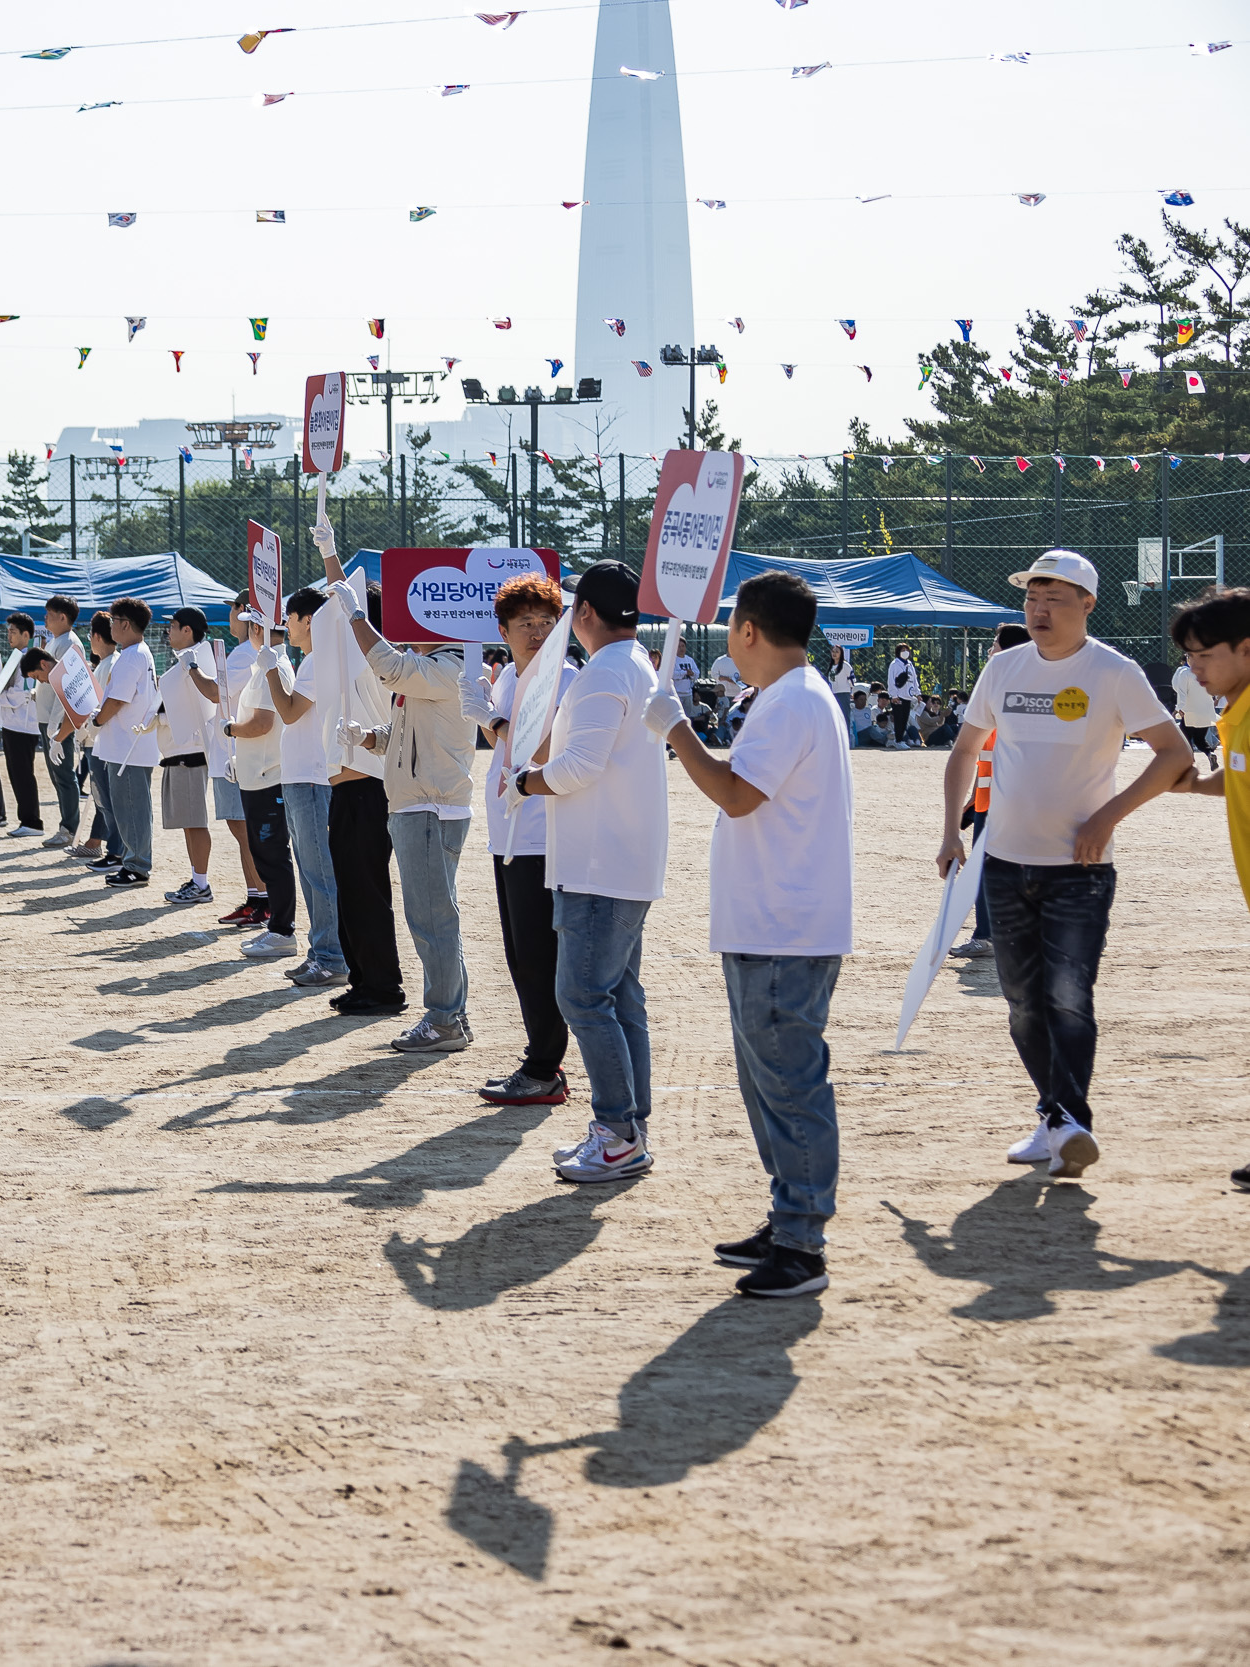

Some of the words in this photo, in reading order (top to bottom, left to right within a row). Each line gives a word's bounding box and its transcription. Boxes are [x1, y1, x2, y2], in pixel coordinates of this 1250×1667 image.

[661, 510, 724, 551] 중곡4동어린이집
[409, 582, 501, 602] 사임당어린
[423, 610, 498, 619] 광진구민간어린이
[826, 632, 867, 641] 한라어린이집
[1015, 694, 1053, 709] DISCO
